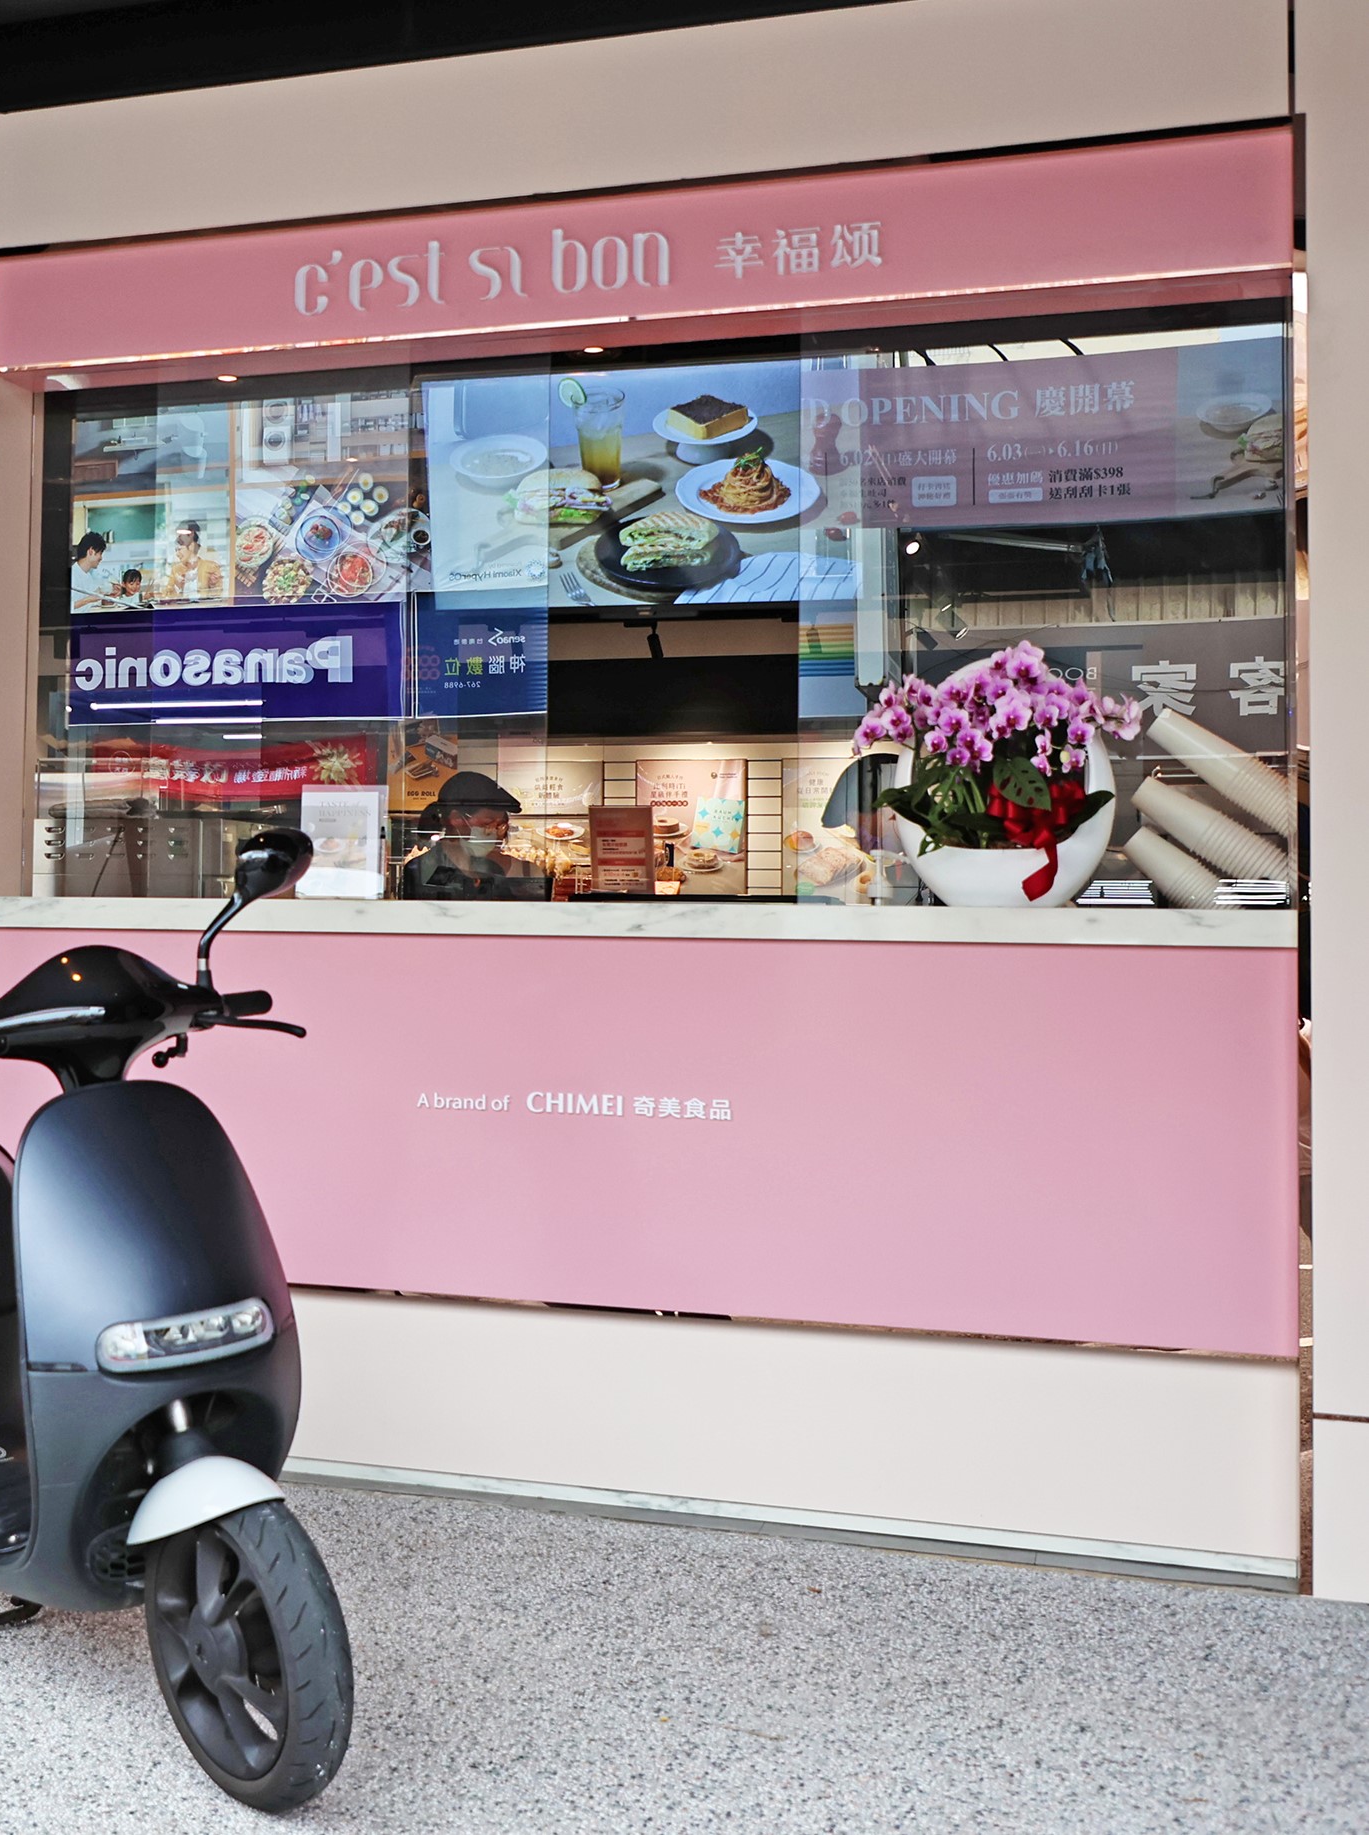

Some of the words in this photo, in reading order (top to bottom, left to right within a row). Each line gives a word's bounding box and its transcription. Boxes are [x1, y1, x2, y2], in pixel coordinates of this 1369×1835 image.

[552, 228, 671, 293] bon
[714, 220, 884, 279] 幸福颂
[840, 391, 1020, 428] OPENING
[1034, 380, 1136, 418] 慶開幕
[1048, 466, 1124, 483] 消費滿$398
[1048, 482, 1131, 500] 送刮刮卡1張
[416, 1093, 430, 1108] A
[433, 1092, 487, 1111] brand
[491, 1095, 510, 1111] of
[526, 1091, 624, 1116] CHIMEI
[633, 1096, 733, 1121] 奇美食品
